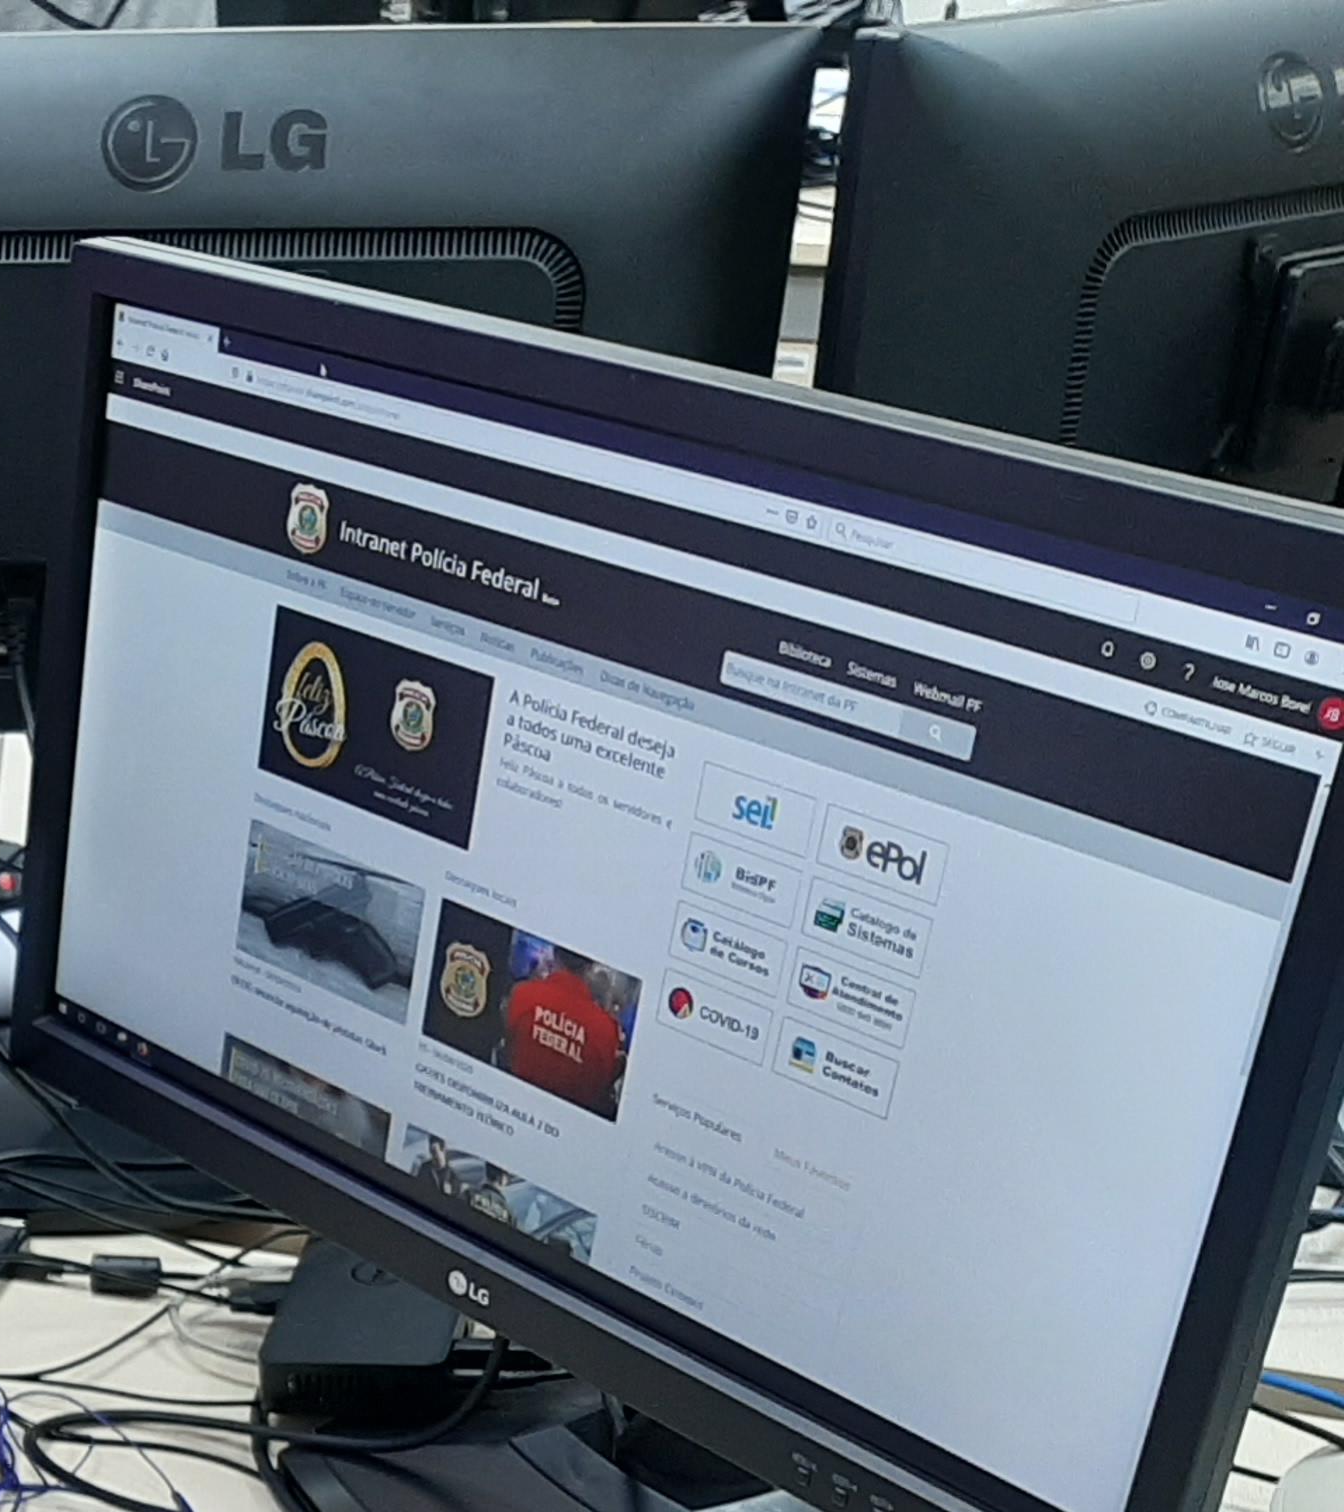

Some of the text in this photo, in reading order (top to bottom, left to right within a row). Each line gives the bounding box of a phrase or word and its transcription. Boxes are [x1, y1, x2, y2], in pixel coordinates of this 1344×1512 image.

[221, 109, 328, 171] LG
[339, 518, 407, 562] Intranet
[410, 540, 467, 580] Polícia
[470, 558, 540, 601] Federal
[777, 637, 832, 670] Biblioteca
[846, 659, 898, 690] Sistemas
[912, 678, 983, 714] Webmail PF
[1237, 680, 1280, 706] Marcos
[509, 688, 520, 706] A
[571, 706, 625, 742] Federal
[626, 726, 676, 764] deseja
[503, 729, 551, 764] Páscoa
[506, 713, 666, 781] a todos uma excelente
[863, 831, 928, 887] ePol
[846, 920, 915, 961] Sistemas
[727, 950, 770, 978] Cursos
[840, 975, 881, 1001] Central
[533, 1002, 586, 1044] POLÍCIA
[698, 1003, 760, 1043] COVID-19
[531, 1023, 584, 1064] FEDERAL
[821, 1064, 879, 1099] Contatos
[825, 1050, 869, 1079] Buscar
[468, 1281, 490, 1306] LG
